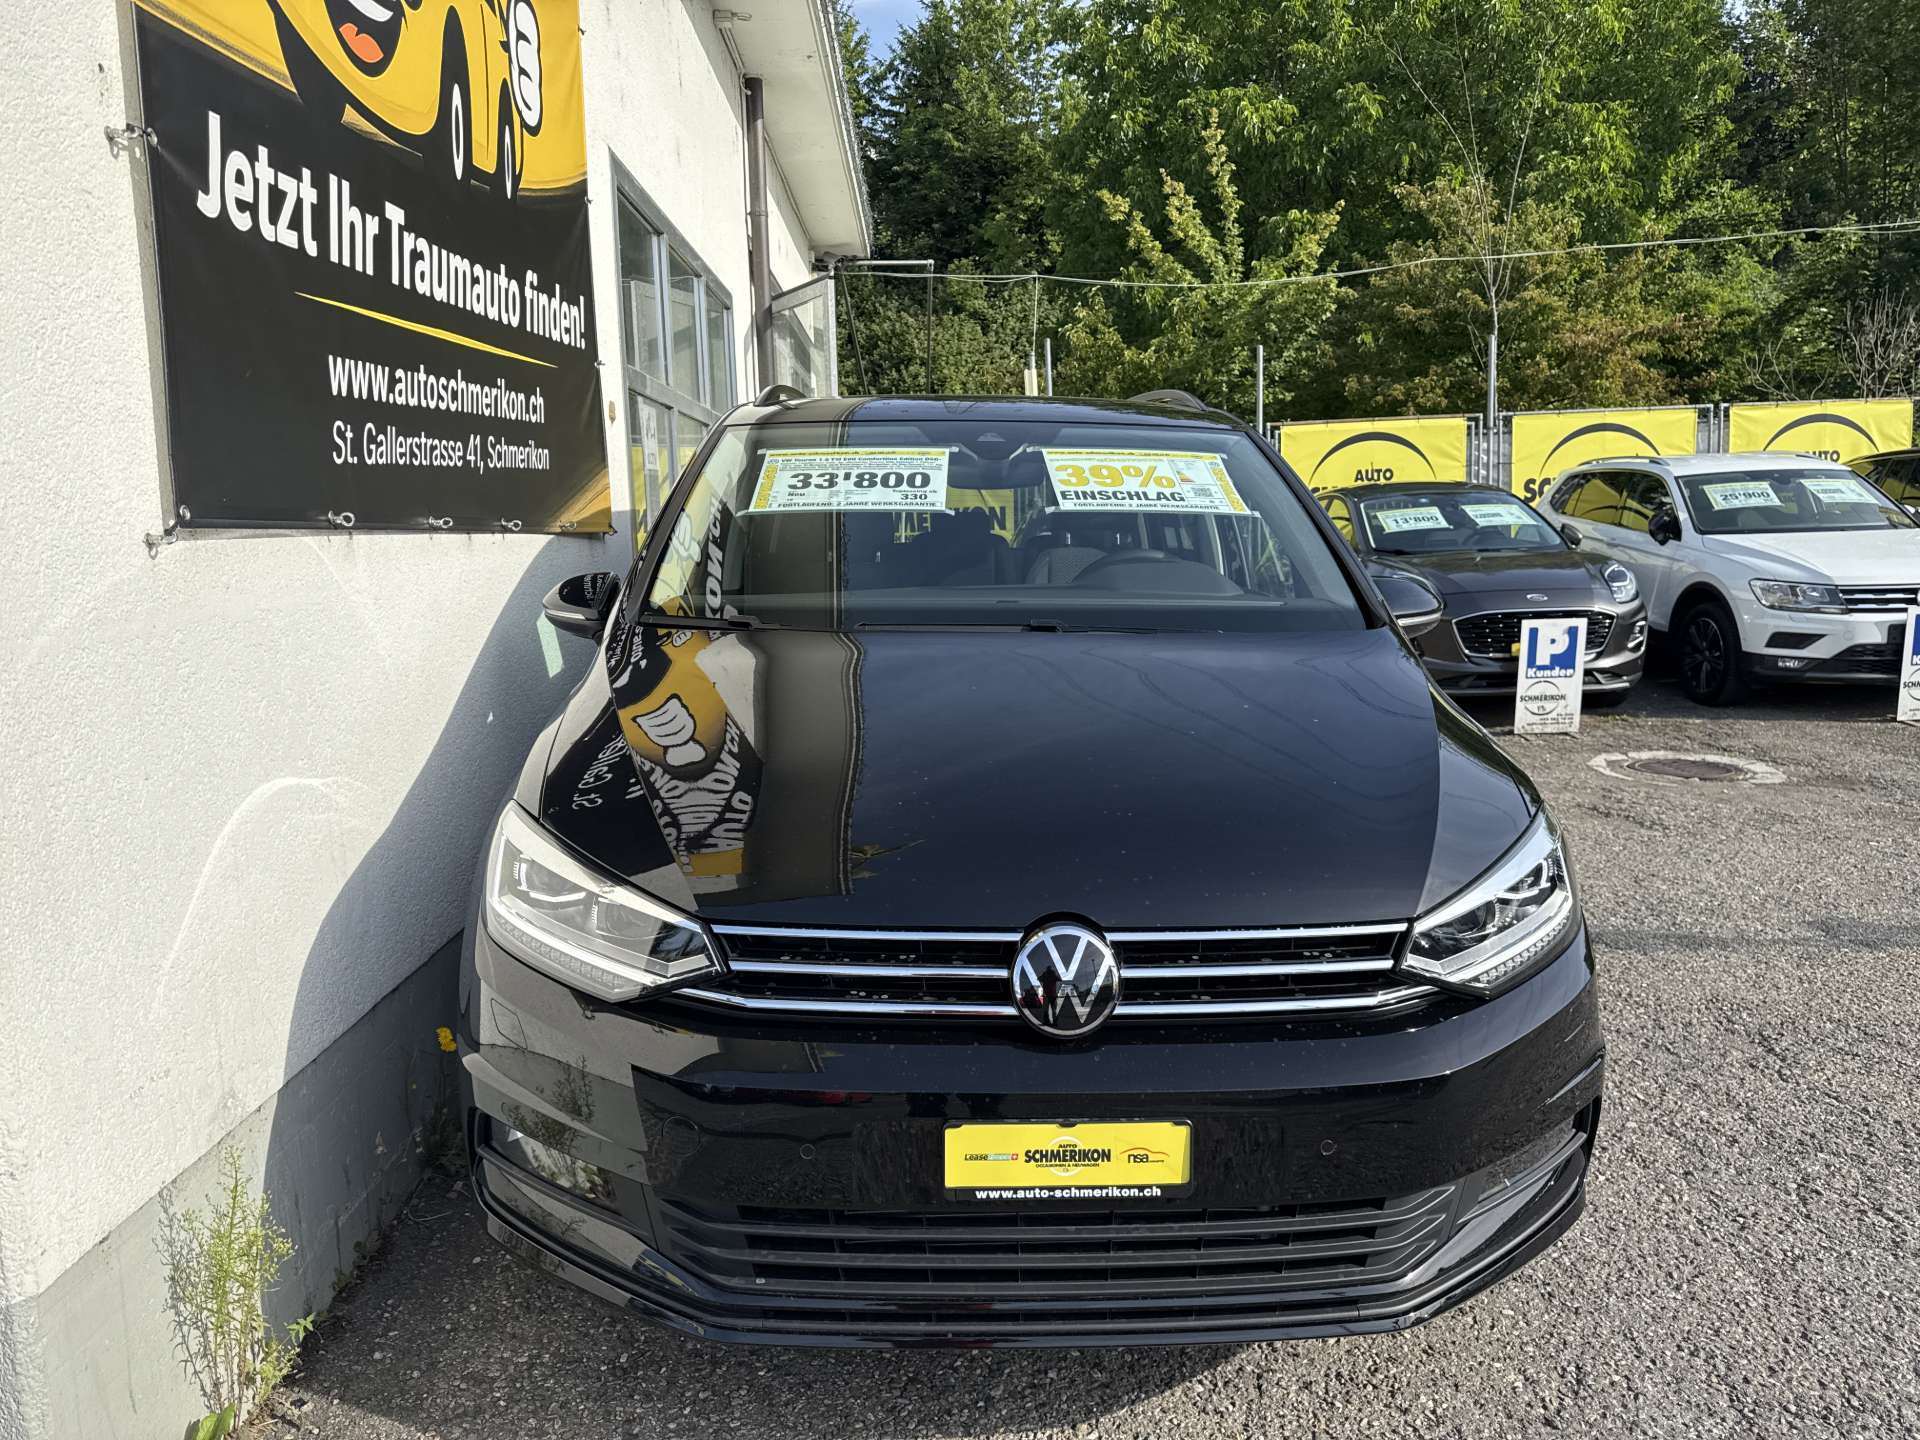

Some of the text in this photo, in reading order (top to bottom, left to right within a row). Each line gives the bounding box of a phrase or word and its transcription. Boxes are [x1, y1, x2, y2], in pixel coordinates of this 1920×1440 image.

[196, 110, 586, 350] Jetzt Ihr Traumauto finden!
[328, 353, 545, 424] www.autoschmerikon.ch
[332, 420, 550, 475] St. Gallerstrasse 41, Schmerikon
[788, 471, 931, 489] 33'800
[1054, 464, 1176, 489] 39%
[1354, 468, 1394, 483] AUTO
[901, 493, 928, 501] 330
[1060, 489, 1186, 502] EINSCHLAG
[1392, 515, 1440, 525] 13'800
[1536, 626, 1569, 666] P
[1527, 666, 1574, 677] Kunden
[1520, 694, 1566, 702] SCHMERIKON
[1024, 1148, 1112, 1164] SCHMERIKON
[1127, 1153, 1149, 1164] nsa
[975, 1185, 1162, 1200] www.auto-schmerikon.ch
